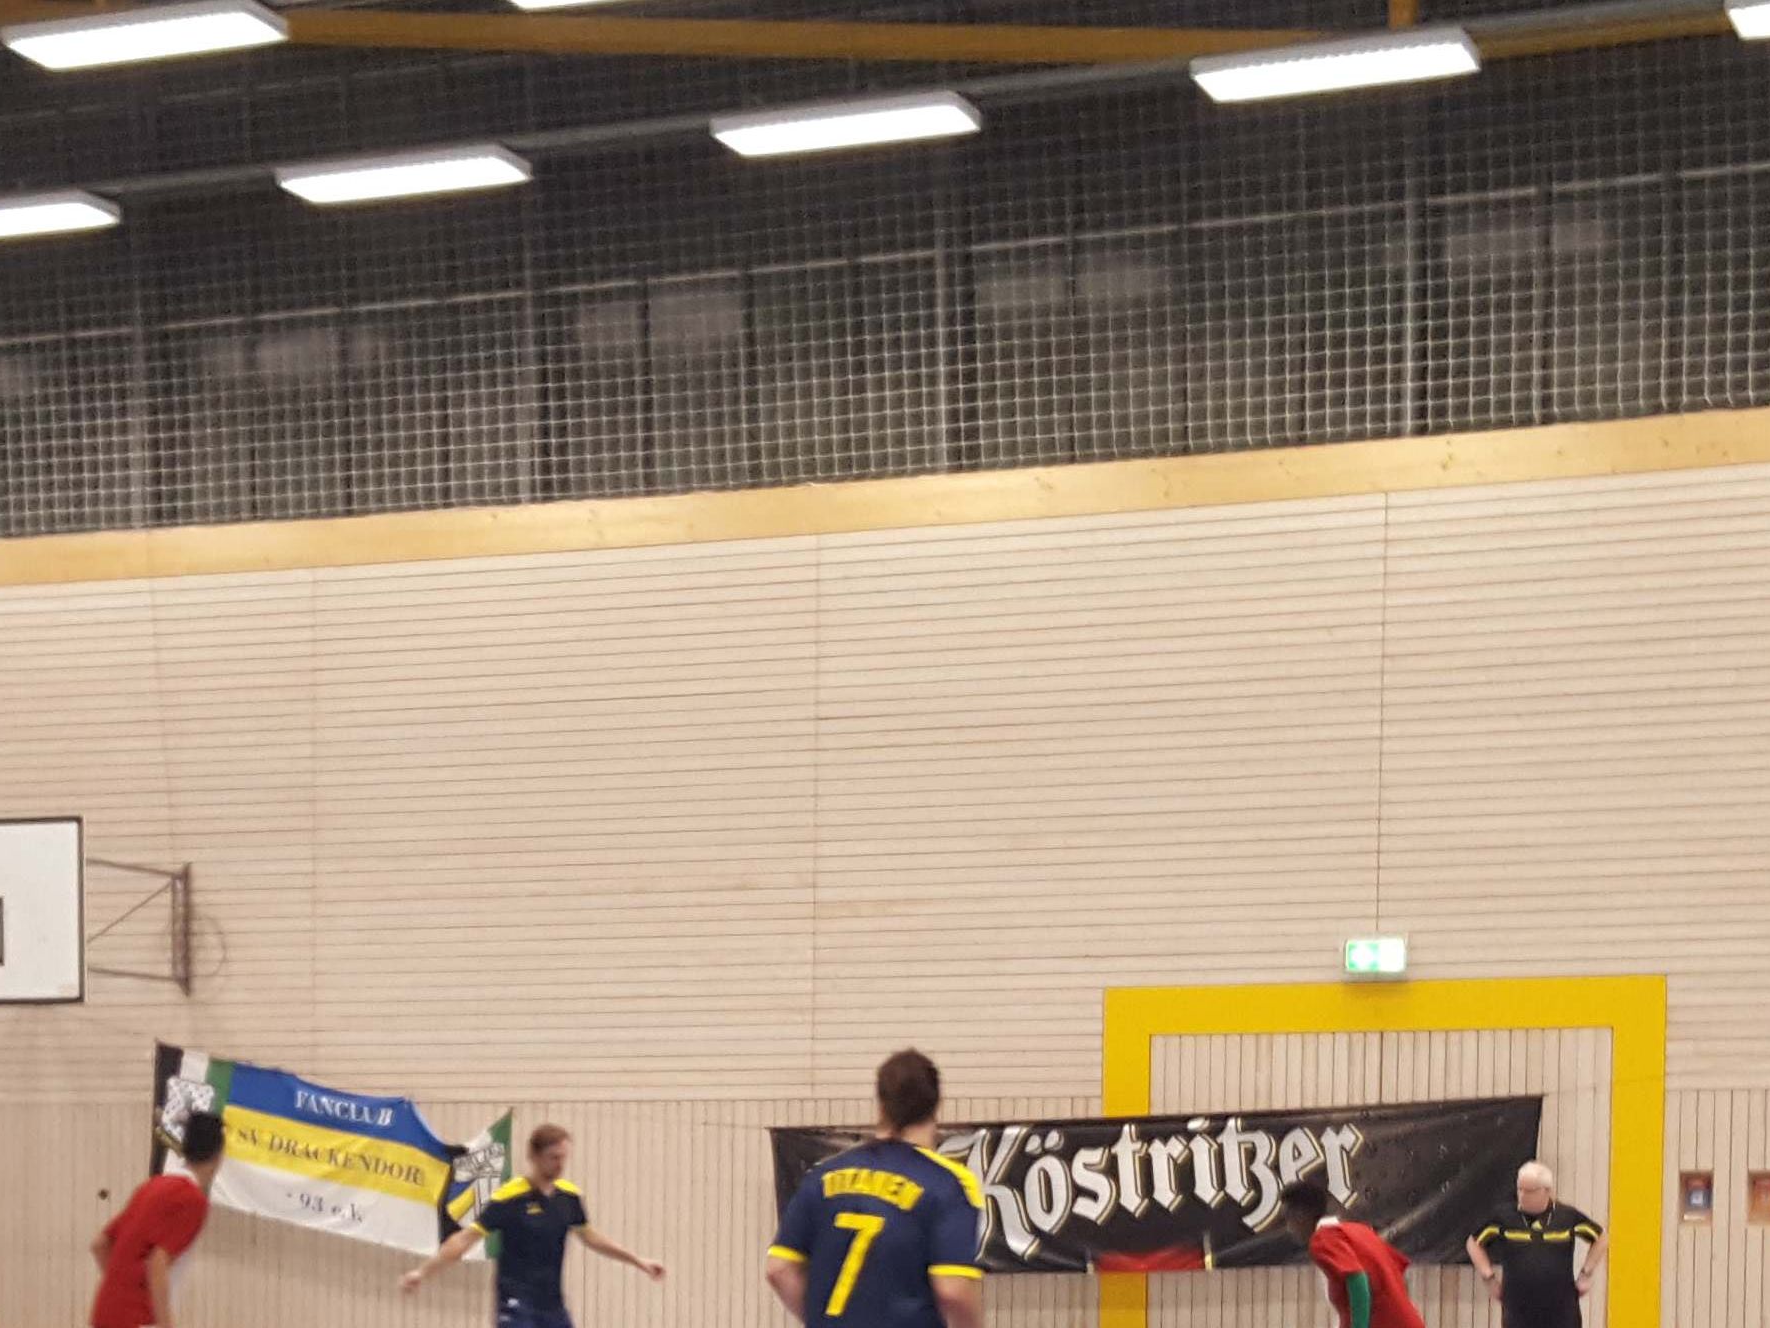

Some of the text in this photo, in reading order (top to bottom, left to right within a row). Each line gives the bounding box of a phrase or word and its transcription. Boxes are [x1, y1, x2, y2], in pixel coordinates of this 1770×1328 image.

[294, 1089, 395, 1126] FANCLUB
[937, 1116, 1365, 1260] Köstritzer
[824, 1212, 886, 1317] 7
